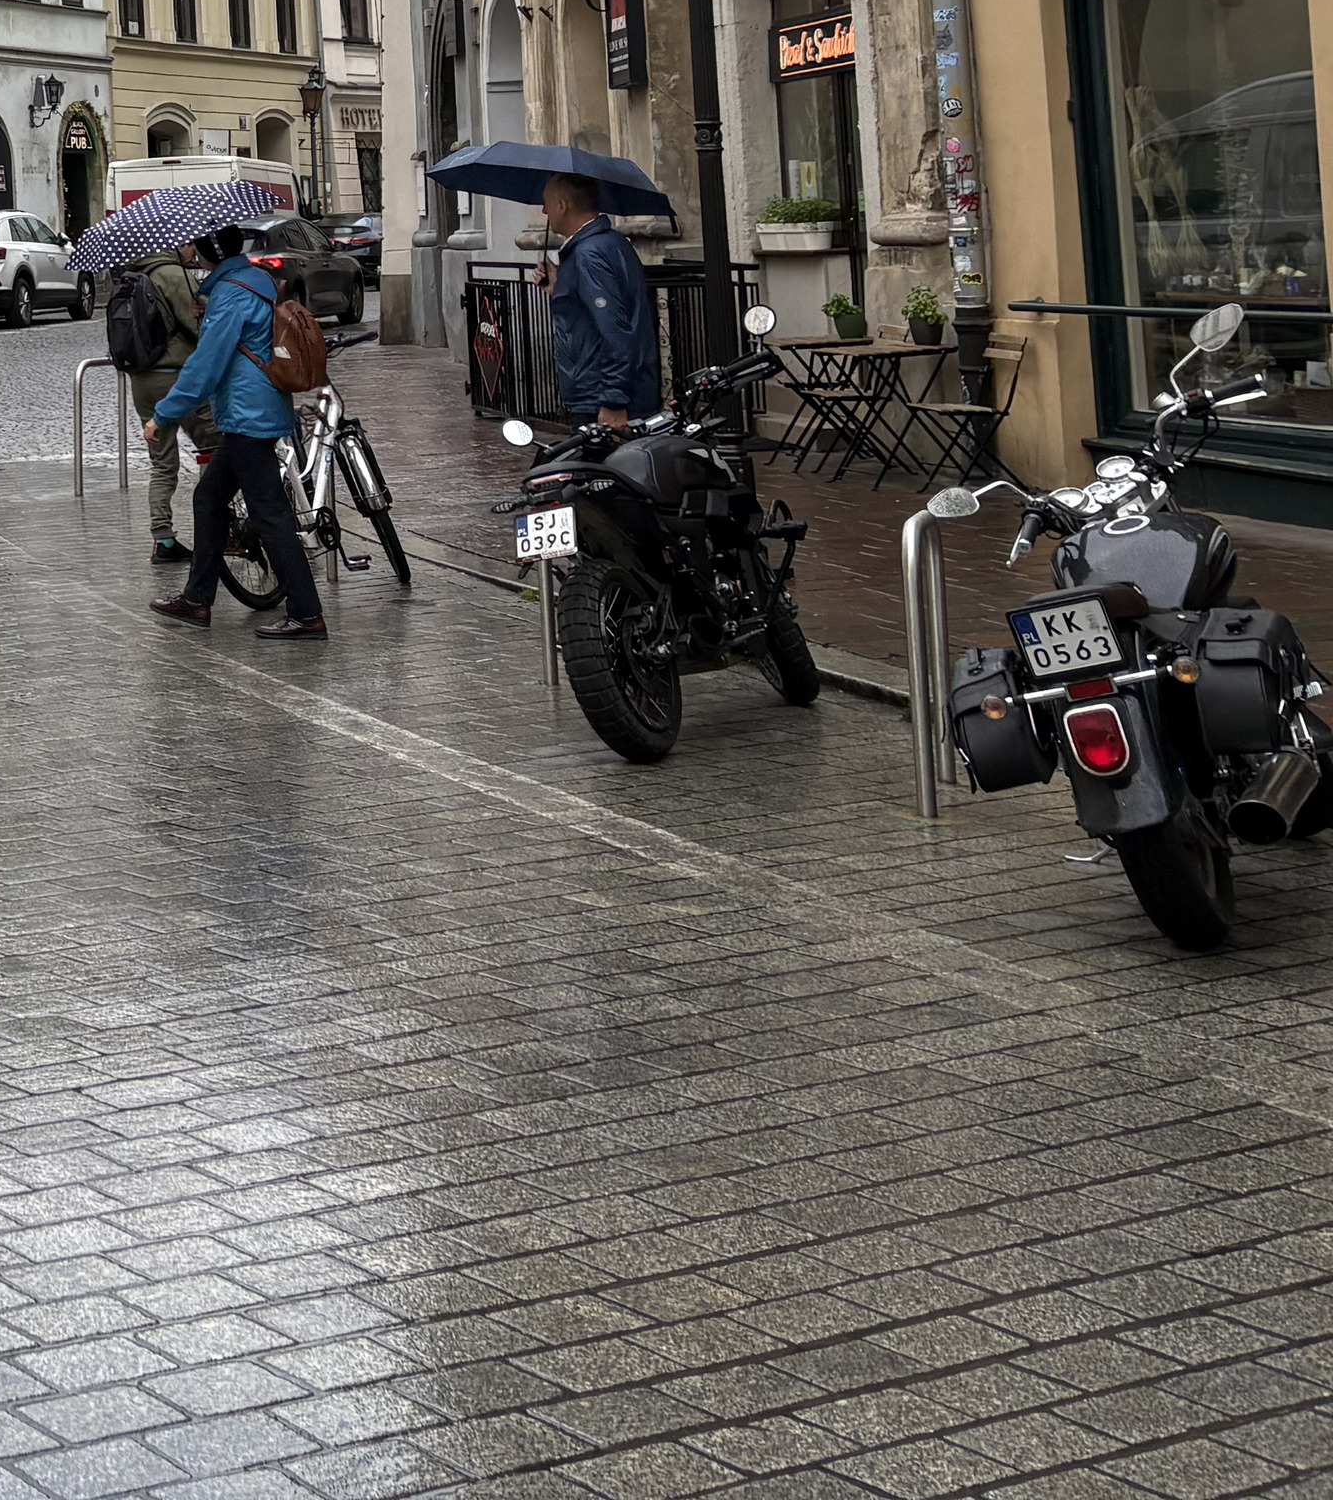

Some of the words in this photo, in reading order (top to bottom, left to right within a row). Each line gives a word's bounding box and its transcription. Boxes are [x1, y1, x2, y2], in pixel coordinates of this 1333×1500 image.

[806, 37, 815, 62] &
[70, 136, 87, 149] PUB
[534, 513, 556, 531] SJ
[521, 531, 571, 553] 039C
[1042, 610, 1084, 637] KK
[1022, 633, 1039, 645] PL
[1033, 636, 1112, 669] 0563
